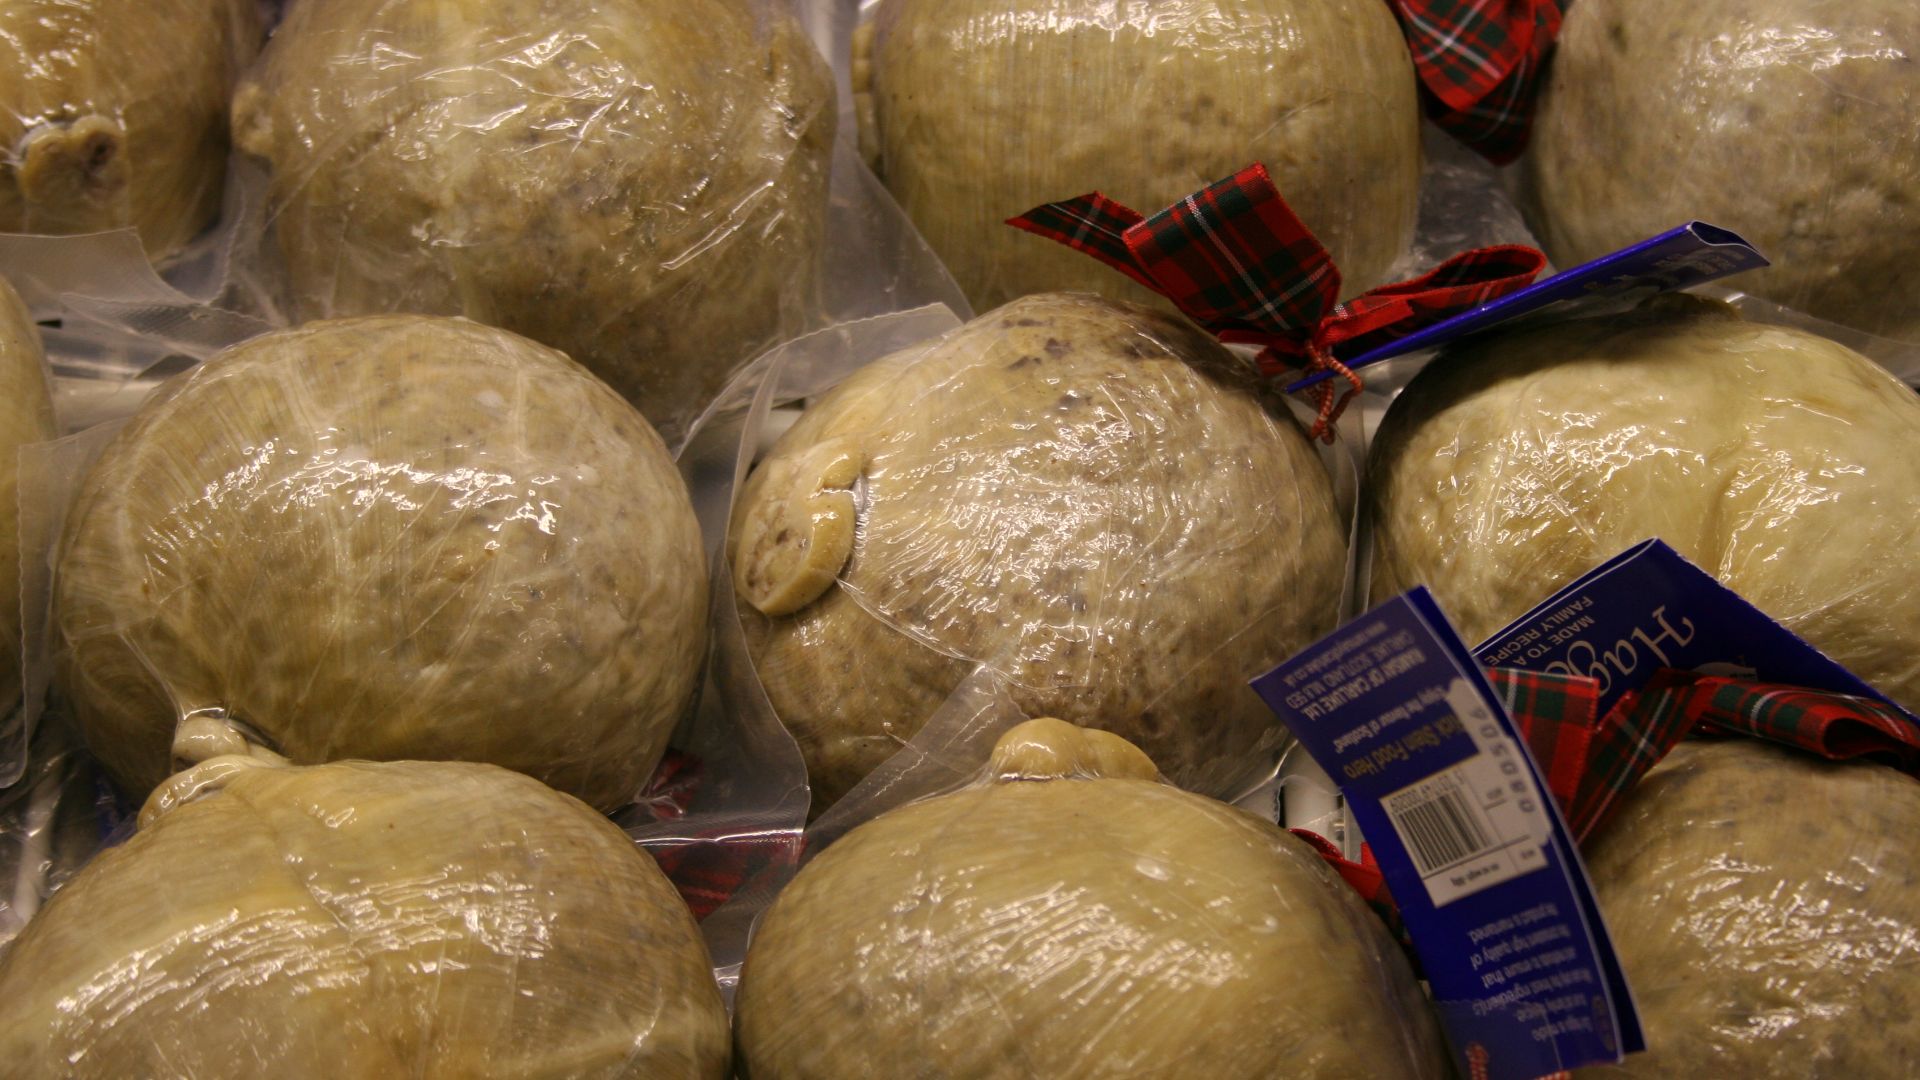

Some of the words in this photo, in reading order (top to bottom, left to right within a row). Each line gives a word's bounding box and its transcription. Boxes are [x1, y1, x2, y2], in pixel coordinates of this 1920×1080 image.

[1540, 595, 1594, 632] FAMILY
[1551, 615, 1595, 645] MADE
[1484, 629, 1541, 666] RECIPE
[1530, 643, 1552, 659] TO
[1545, 604, 1695, 696] Hag
[1382, 648, 1426, 680] RAMSAY
[1513, 655, 1527, 666] A
[1367, 667, 1386, 687] OF
[1320, 676, 1371, 712] CARLUKE
[1405, 698, 1424, 713] the
[1368, 720, 1381, 735] of
[1371, 740, 1409, 770] Food
[1343, 756, 1379, 778] Hero
[1470, 953, 1482, 970] of
[1481, 969, 1505, 989] that
